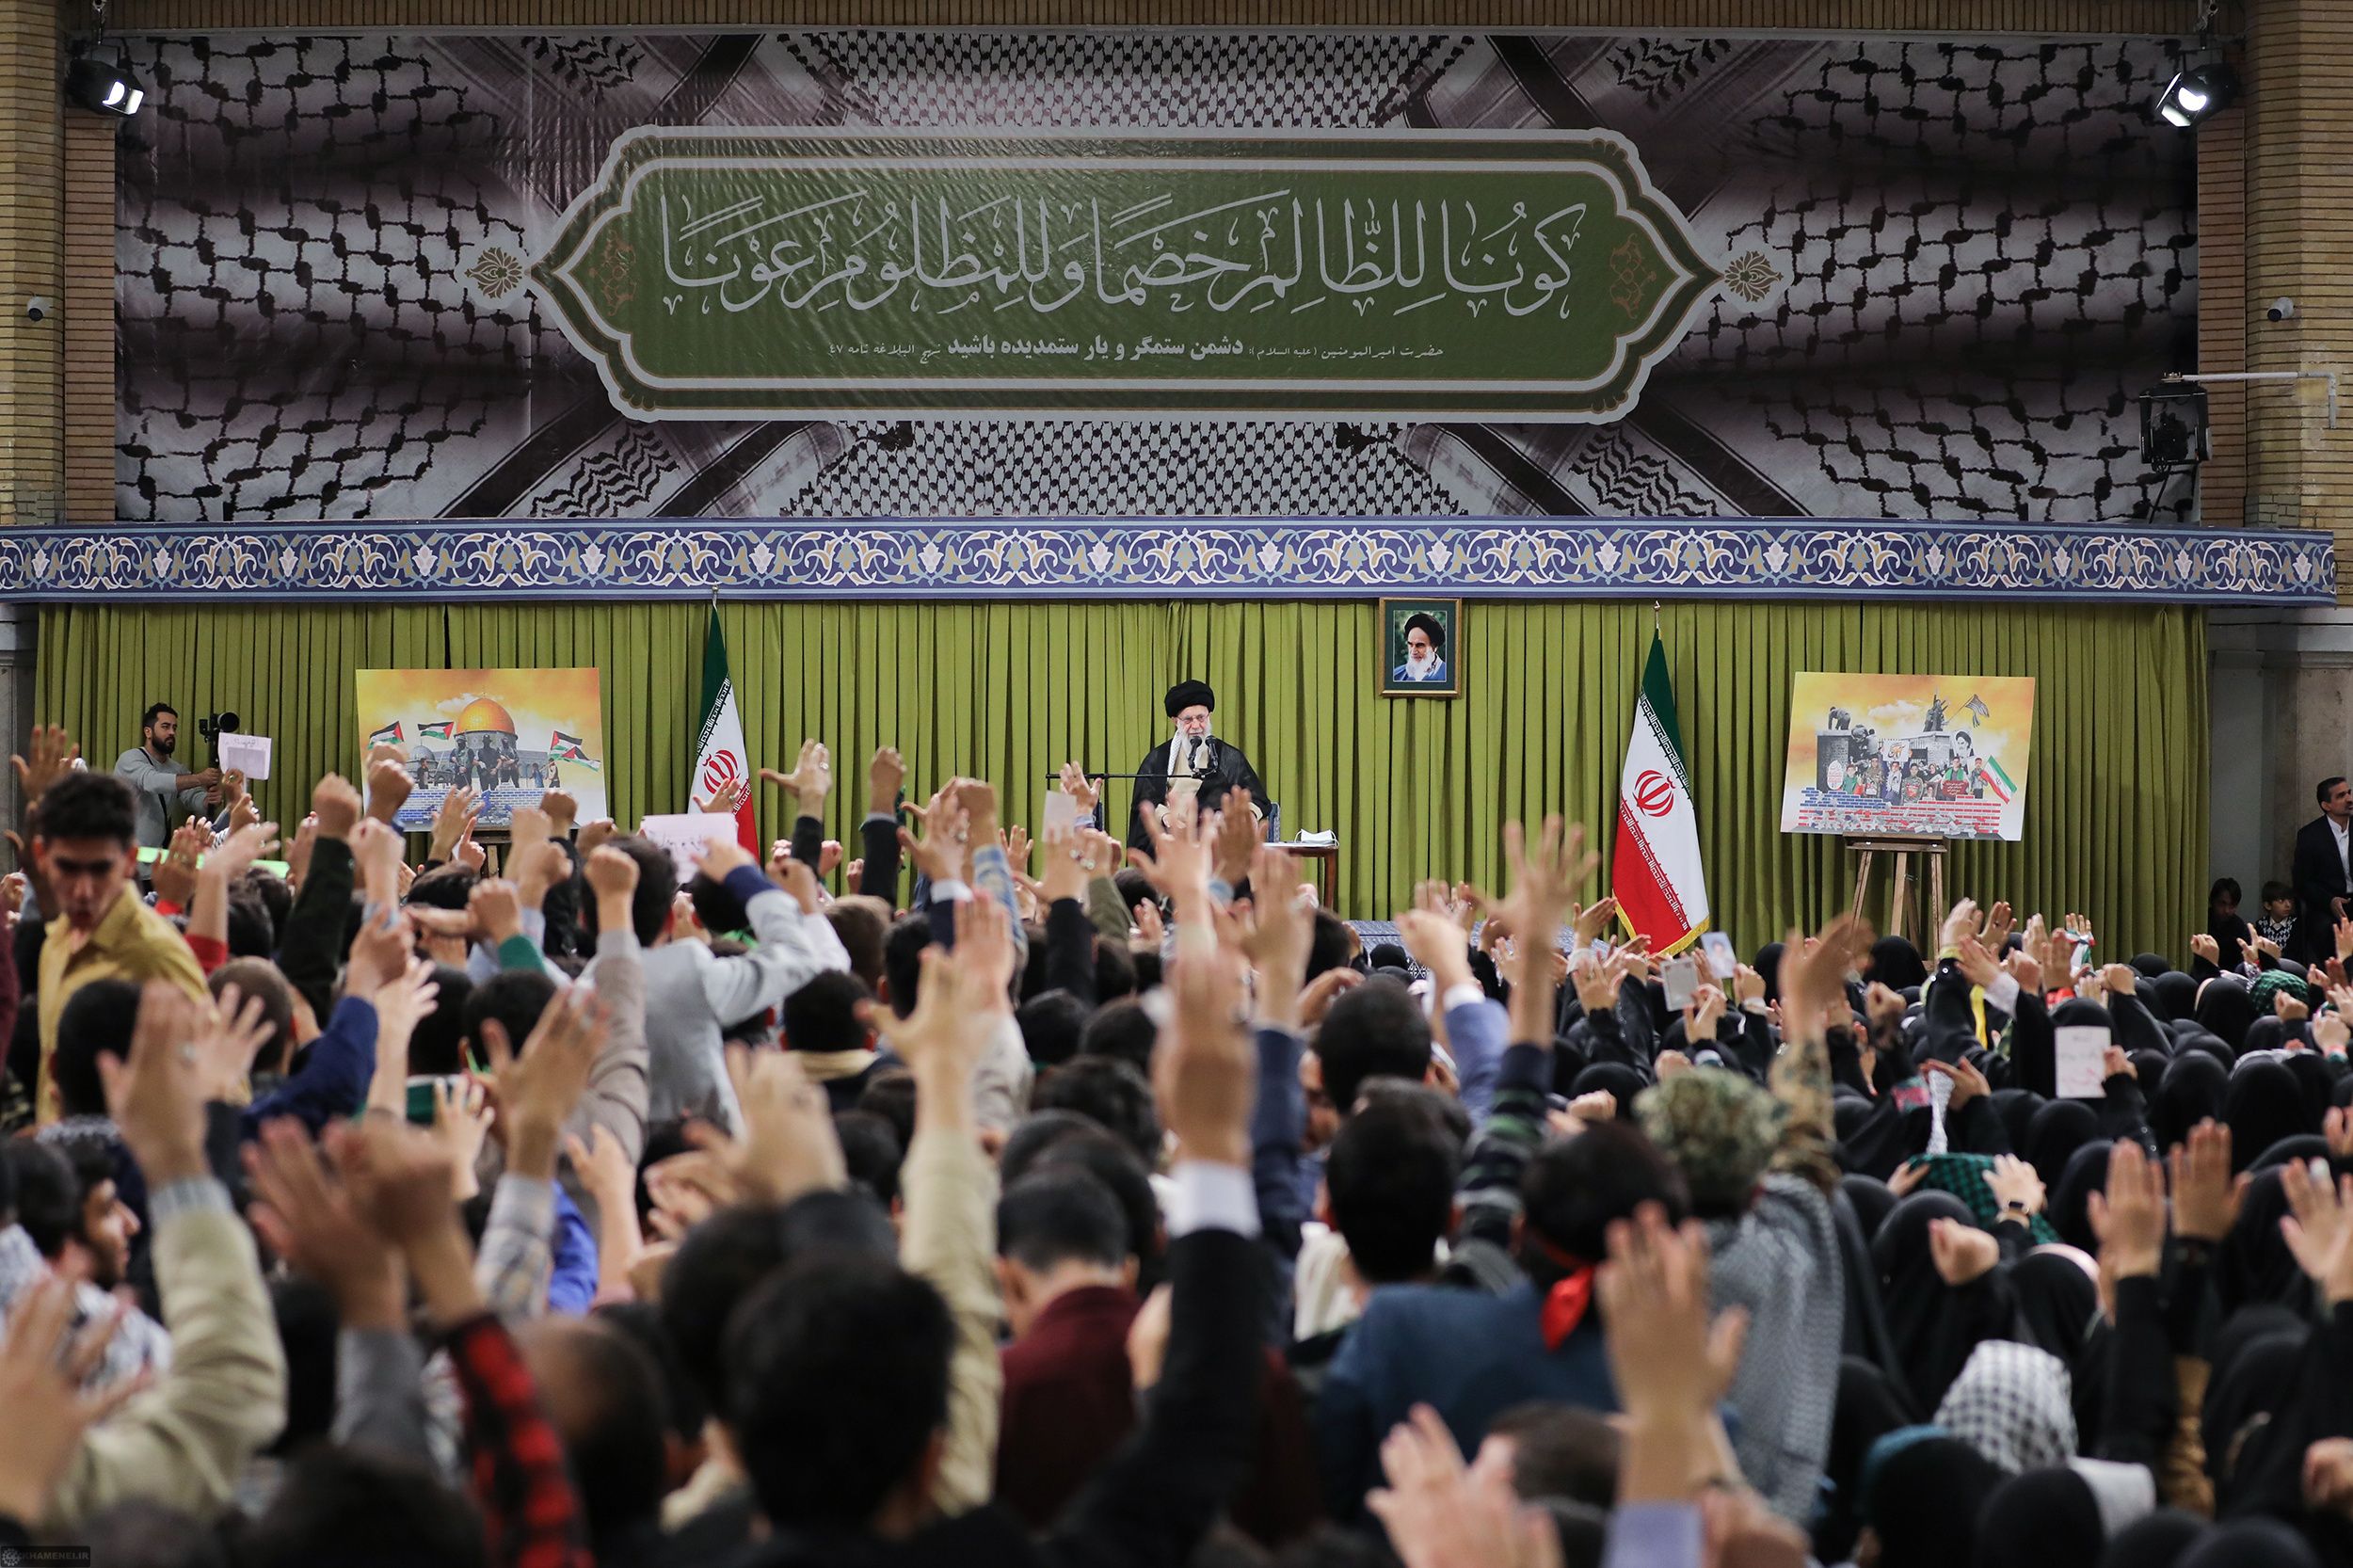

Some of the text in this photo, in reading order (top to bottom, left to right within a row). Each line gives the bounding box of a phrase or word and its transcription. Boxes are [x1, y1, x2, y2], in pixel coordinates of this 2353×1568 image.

[848, 344, 869, 355] نامه
[1114, 343, 1125, 360] و
[1130, 335, 1185, 360] ستمگر
[1191, 336, 1243, 360] دشمن
[1401, 344, 1443, 358] حضرت
